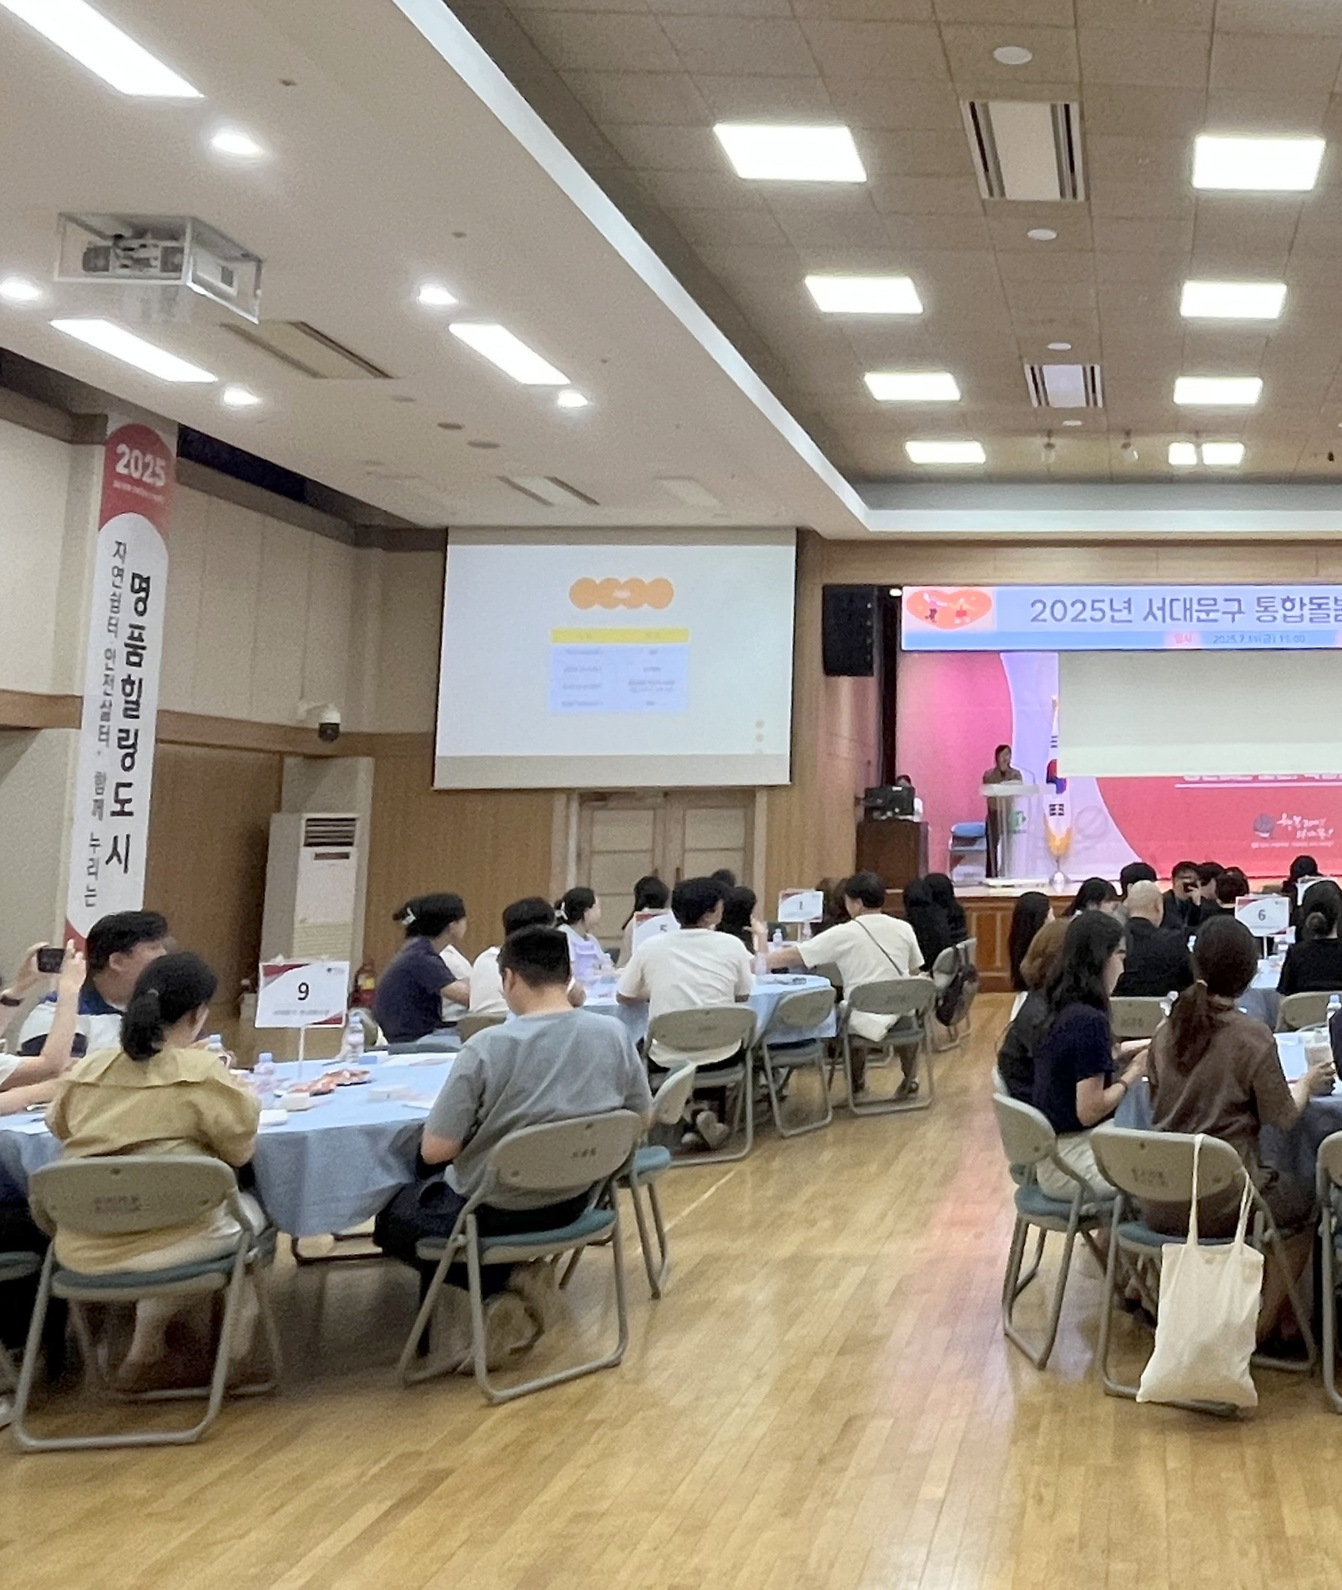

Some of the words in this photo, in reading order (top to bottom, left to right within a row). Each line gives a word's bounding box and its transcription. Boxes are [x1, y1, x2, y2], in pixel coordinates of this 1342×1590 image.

[115, 443, 166, 487] 2025
[1030, 597, 1133, 624] 2025년
[1142, 597, 1246, 624] 서대문구
[105, 572, 151, 875] 명품힐링도시
[1258, 909, 1267, 922] 6
[297, 982, 309, 1001] 9
